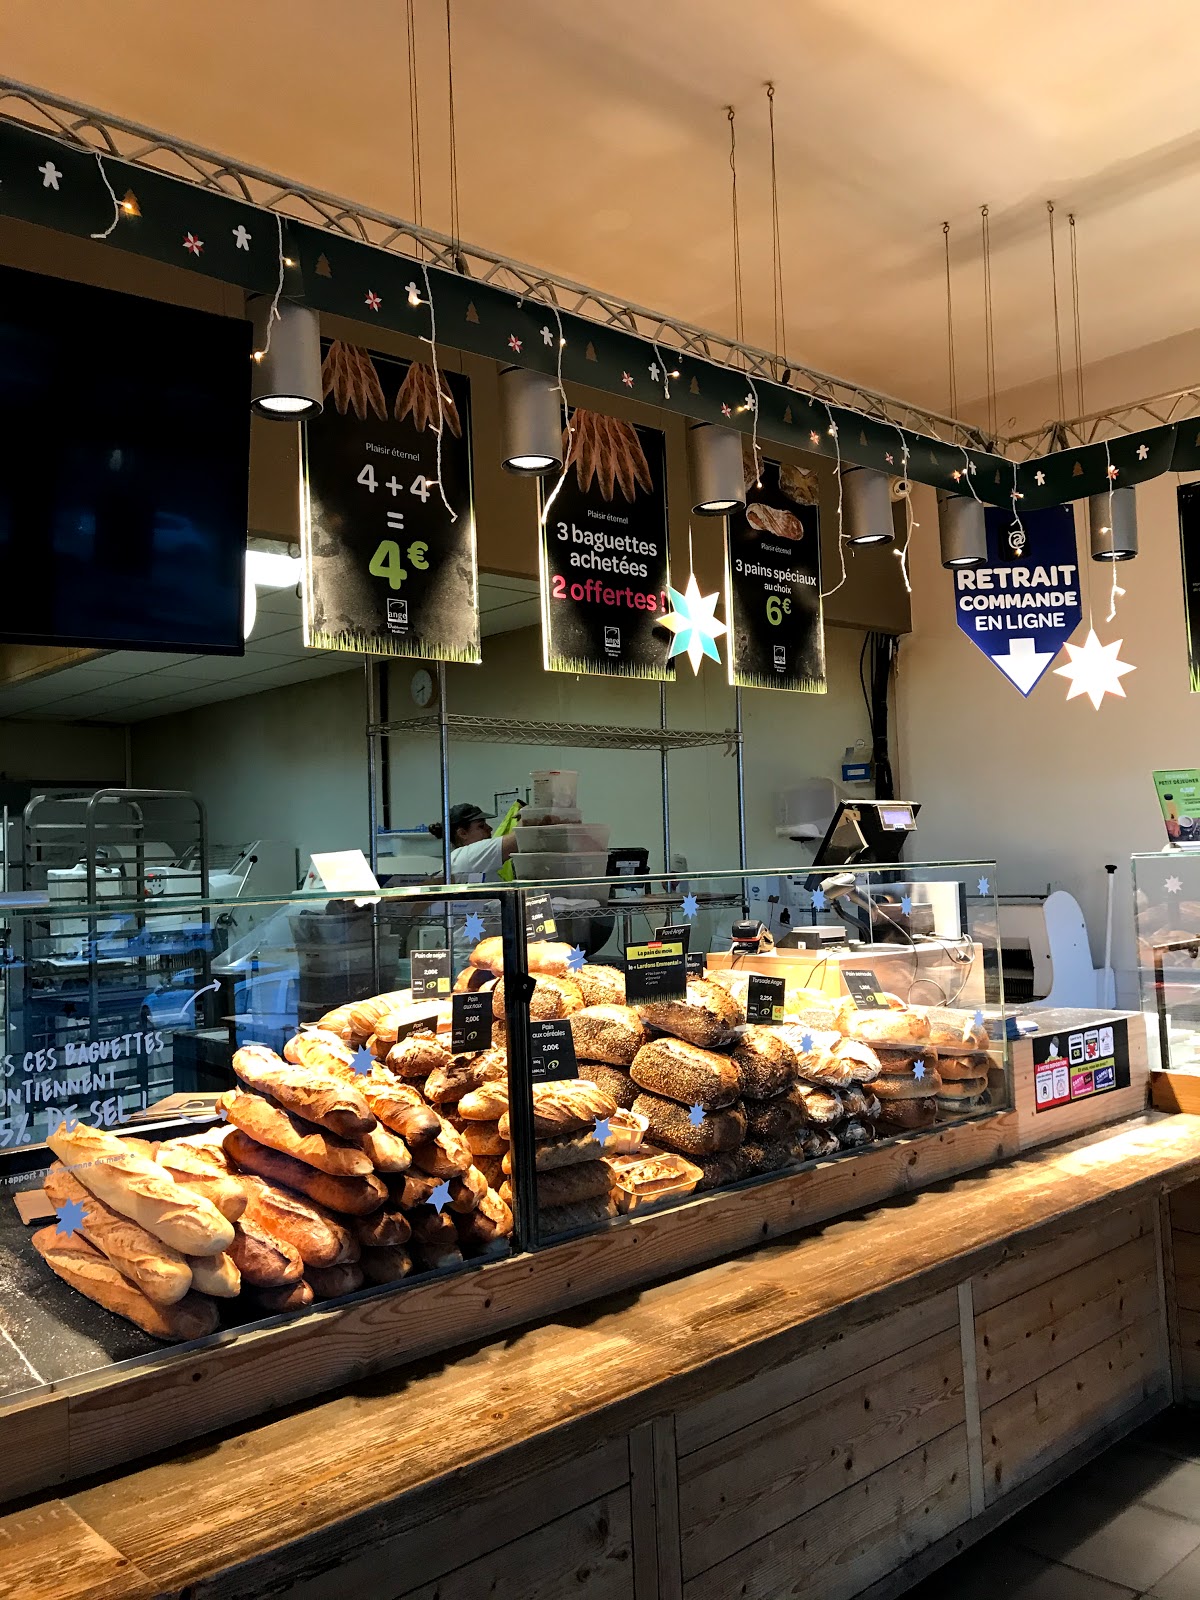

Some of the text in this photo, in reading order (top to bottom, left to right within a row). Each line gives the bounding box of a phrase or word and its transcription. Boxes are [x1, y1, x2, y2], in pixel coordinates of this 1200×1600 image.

[365, 442, 420, 461] Plaisir éternel
[356, 464, 430, 503] 4 + 4
[587, 509, 629, 525] Plaisir éternel
[557, 522, 658, 557] 3 baguettes
[570, 551, 648, 577] achetées
[735, 559, 817, 587] 3 pains spéciaux
[764, 583, 792, 594] au choix
[957, 565, 1076, 590] RETRAIT
[552, 574, 567, 599] 2
[570, 578, 658, 612] offertes
[959, 591, 1077, 611] COMMANDE
[975, 612, 1065, 631] EN LIGNE
[644, 949, 654, 957] pain
[465, 1015, 480, 1023] 2,00€
[23, 1047, 57, 1072] CES
[65, 1031, 165, 1066] BAGUETTES
[542, 1043, 560, 1051] 2,00€
[45, 1103, 80, 1137] DE
[90, 1095, 131, 1129] SEL
